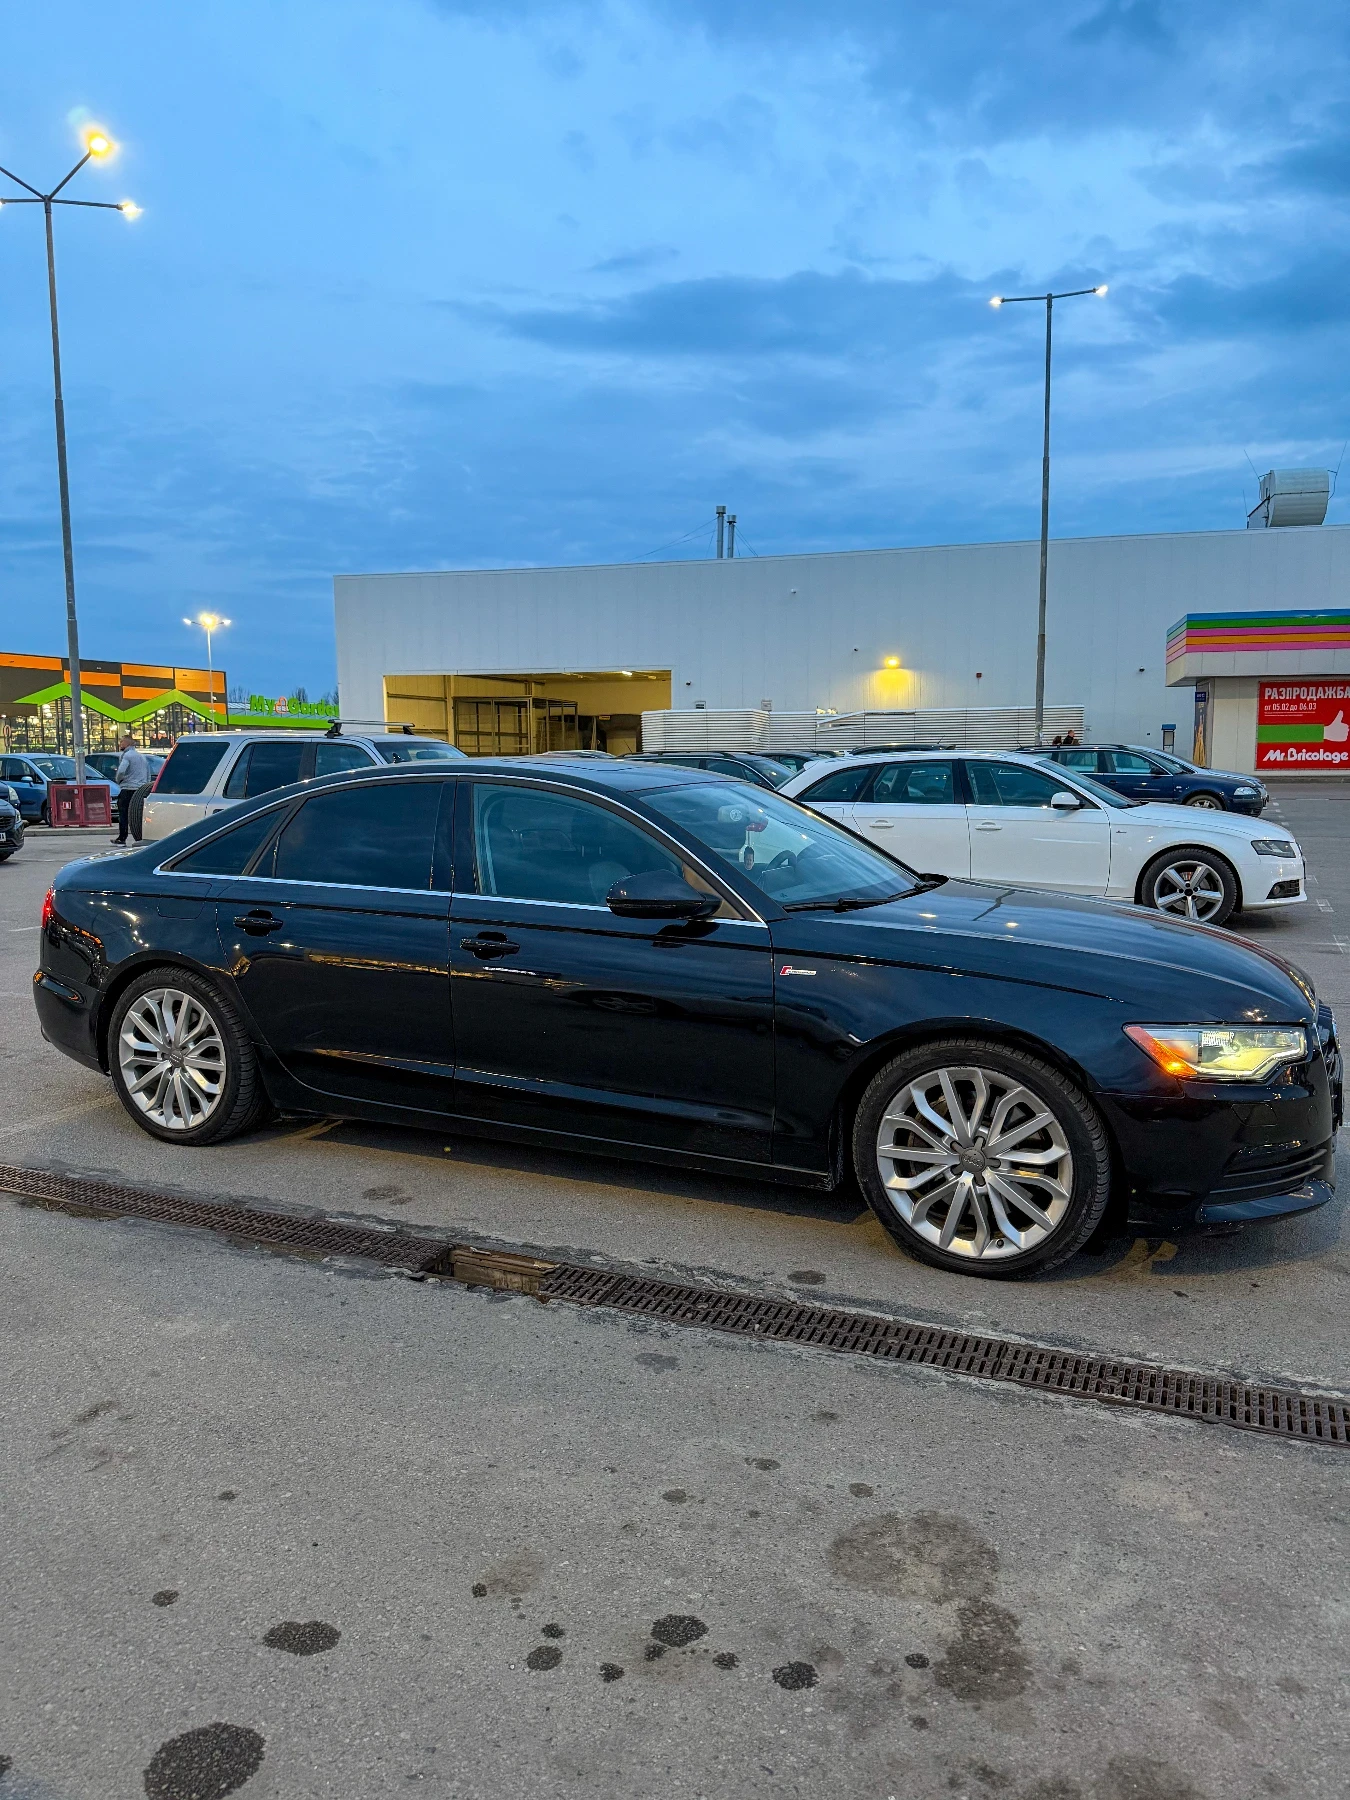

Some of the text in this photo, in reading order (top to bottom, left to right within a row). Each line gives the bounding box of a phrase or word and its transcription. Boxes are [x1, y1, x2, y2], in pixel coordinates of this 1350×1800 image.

[1264, 686, 1350, 701] РАЗПРОДАЖБА
[250, 695, 275, 715] My
[1272, 703, 1289, 711] 05.02
[1290, 704, 1298, 712] до
[1299, 702, 1317, 711] 06.03
